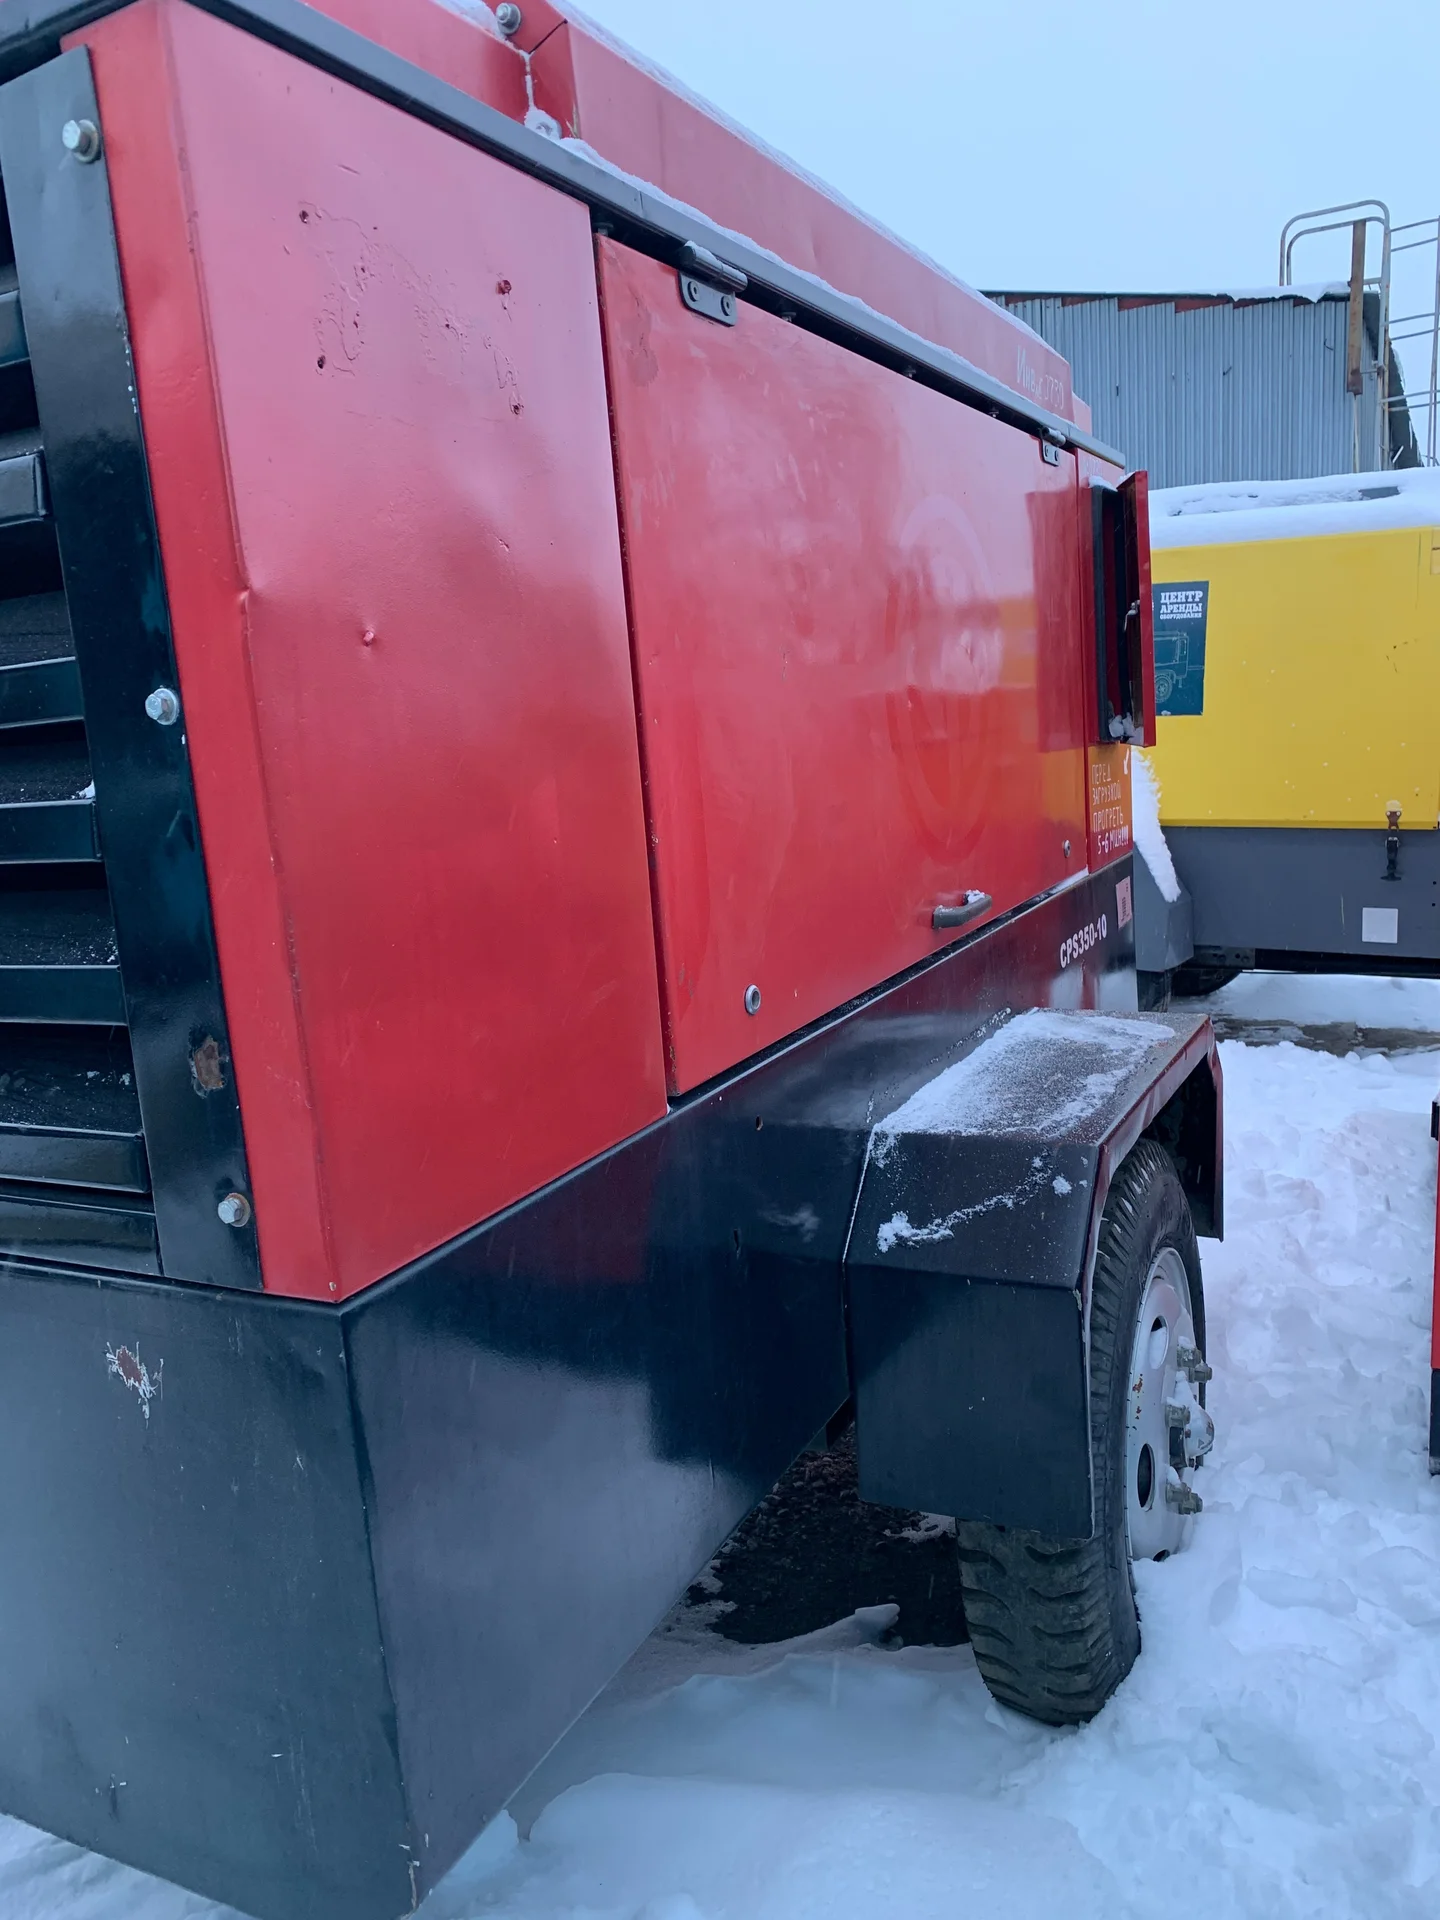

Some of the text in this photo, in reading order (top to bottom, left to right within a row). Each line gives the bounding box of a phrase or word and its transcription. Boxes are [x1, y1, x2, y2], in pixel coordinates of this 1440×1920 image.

[1160, 590, 1203, 604] ЦЕНТР
[1160, 602, 1203, 614] АРЕНДЫ
[1092, 764, 1112, 785] ПЕРЕД
[1092, 780, 1121, 806] ЗАГРУЗКОЙ
[1093, 806, 1124, 833] ПРОГРЕТЬ
[1097, 832, 1109, 855] 5-6
[1060, 913, 1107, 968] CPS350-10
